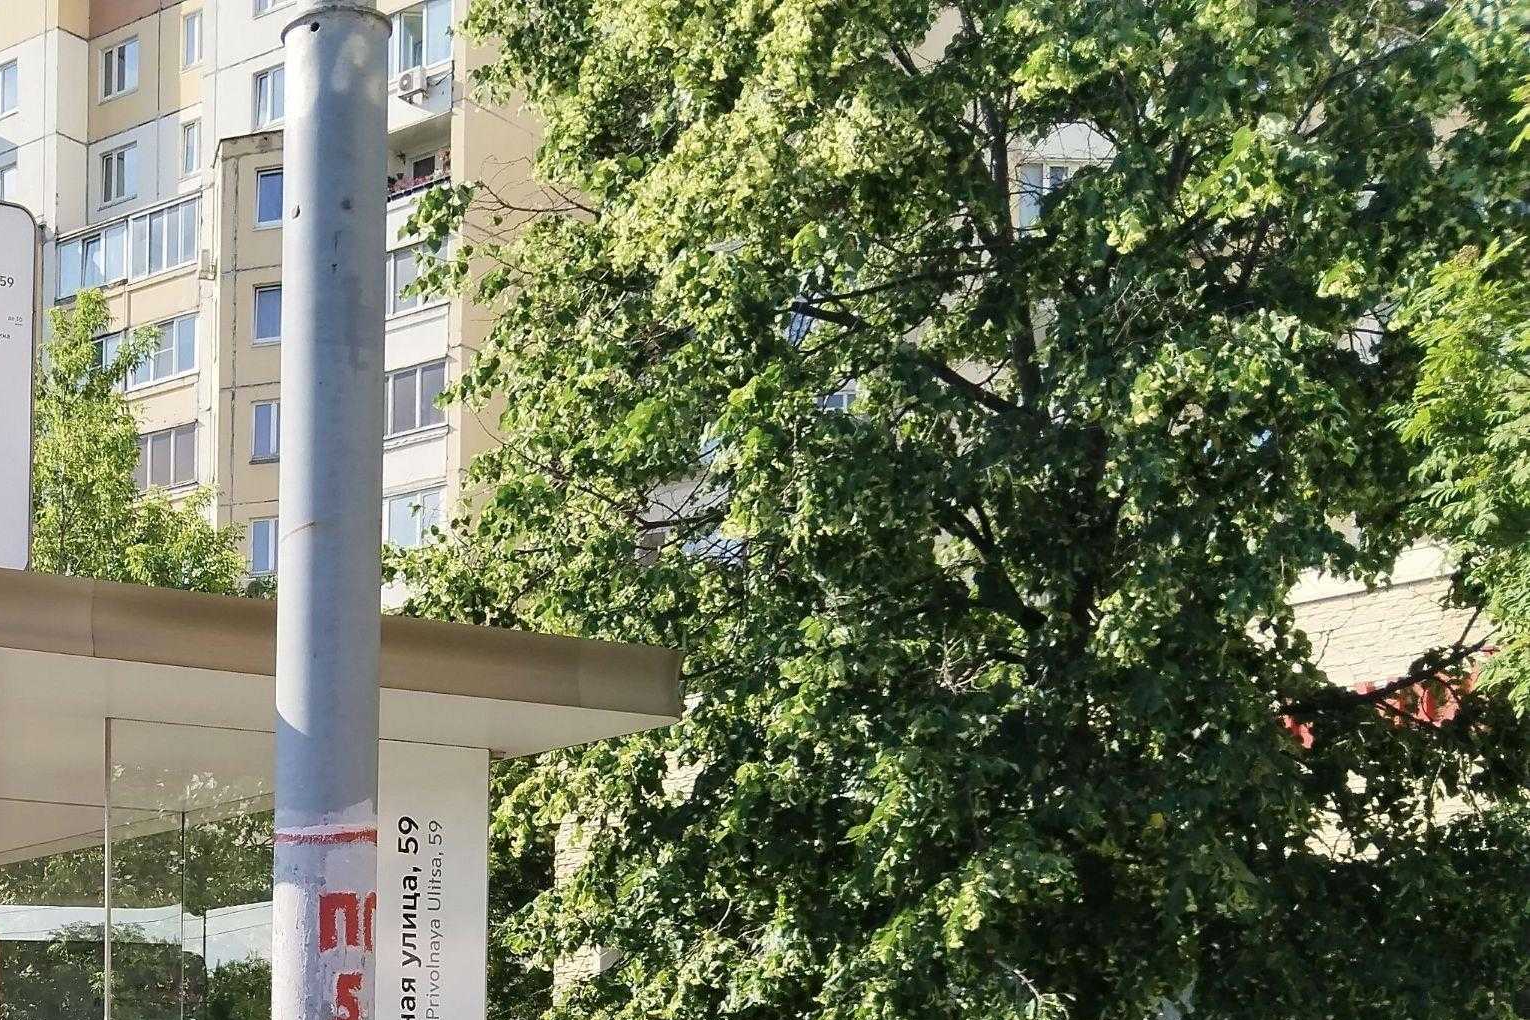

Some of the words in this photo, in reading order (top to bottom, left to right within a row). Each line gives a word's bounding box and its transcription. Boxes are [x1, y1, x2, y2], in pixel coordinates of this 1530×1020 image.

[0, 276, 14, 288] 59
[397, 816, 419, 855] 59
[428, 820, 443, 845] 59
[427, 852, 444, 911] Ulitsa,
[402, 866, 422, 968] улица,
[426, 919, 444, 1020] Privolnaya
